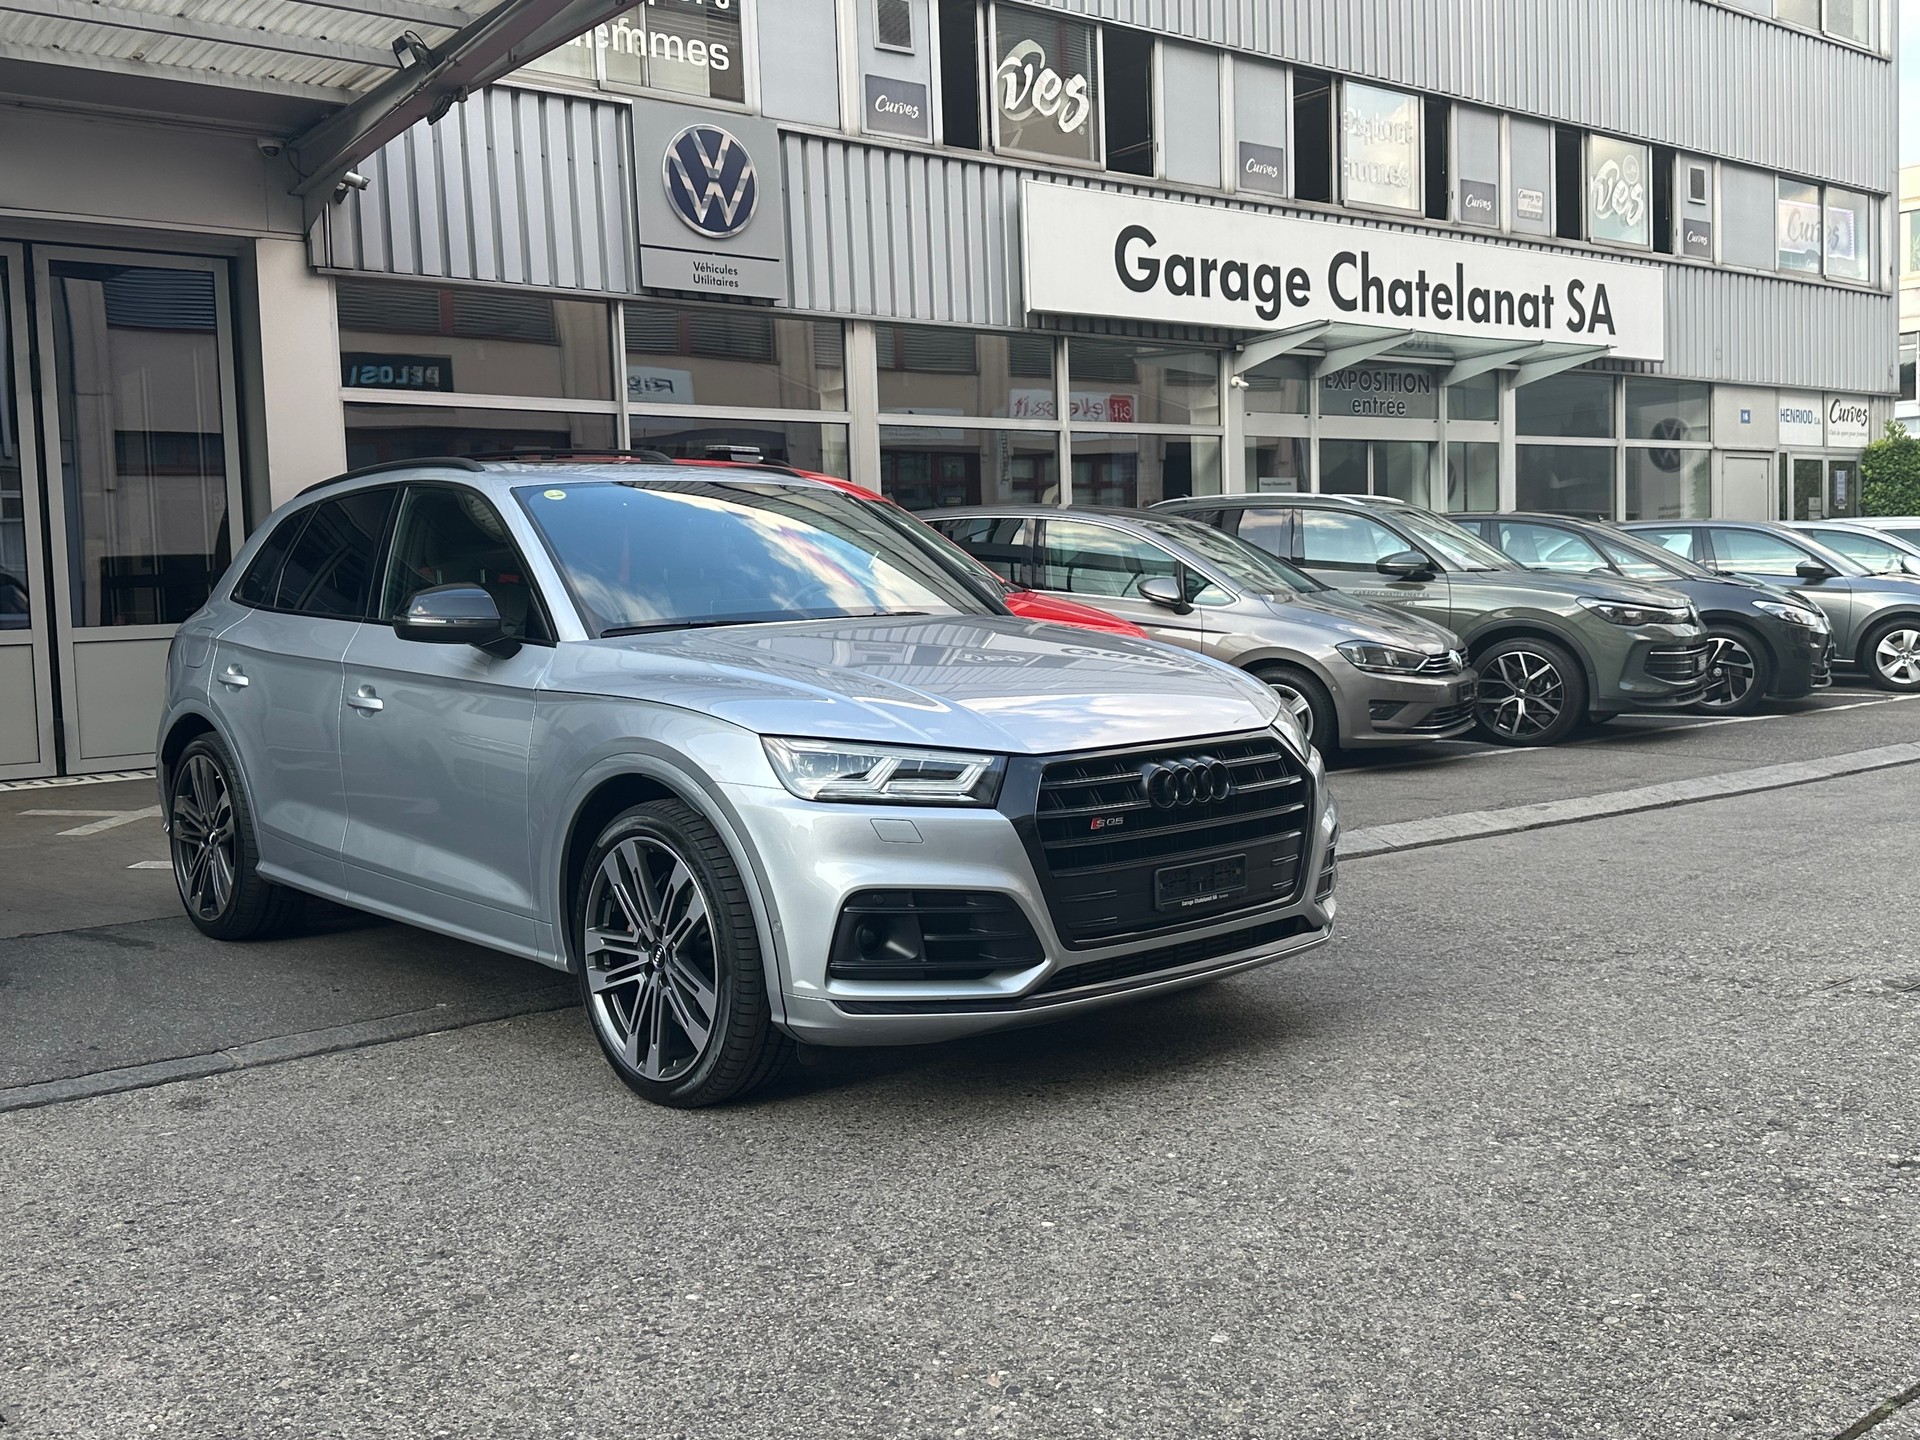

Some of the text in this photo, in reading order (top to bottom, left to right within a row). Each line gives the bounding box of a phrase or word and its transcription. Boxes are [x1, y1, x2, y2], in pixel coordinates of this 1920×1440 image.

[875, 94, 920, 119] Curves
[1245, 158, 1278, 178] Curves
[1465, 193, 1492, 211] Curves
[1686, 230, 1708, 246] Curves
[693, 261, 738, 276] Véhicules
[693, 273, 739, 288] Utilitaires
[1114, 224, 1616, 336] Garage Chatelanat SA
[1324, 369, 1431, 394] EXPOSITION
[1351, 395, 1406, 416] entrée
[1829, 398, 1868, 427] Curves
[1780, 408, 1813, 425] HENRIOD
